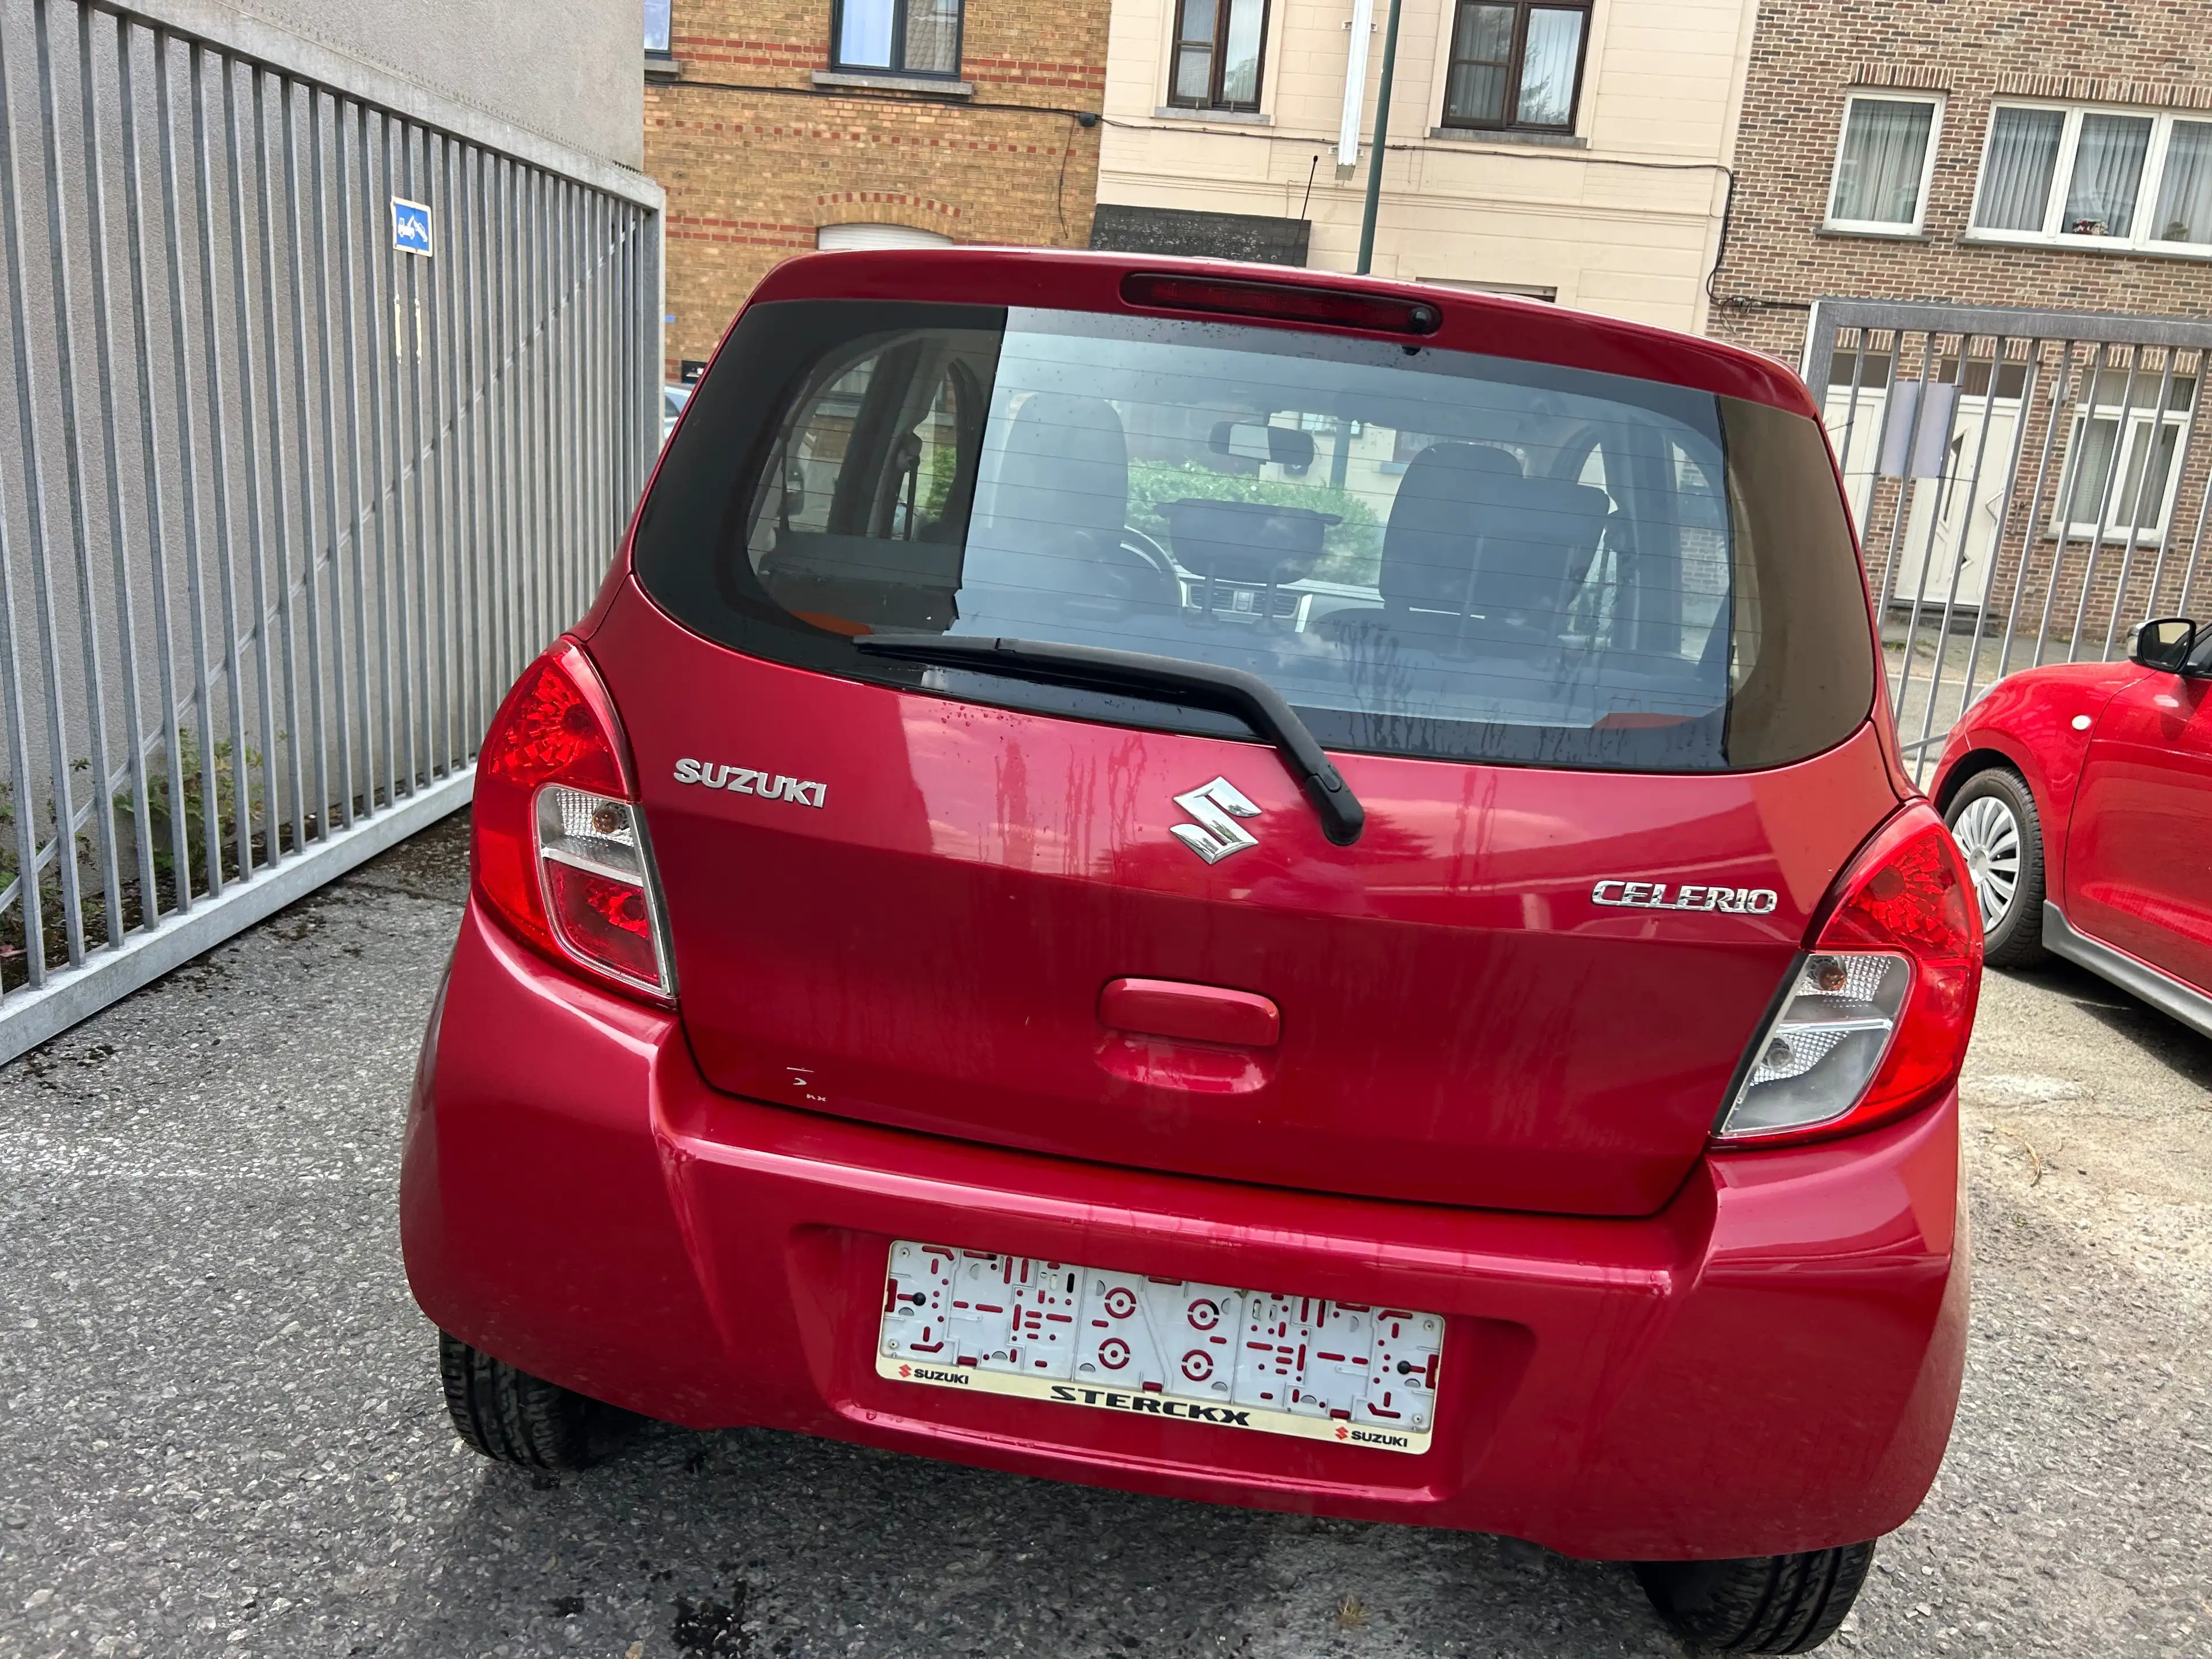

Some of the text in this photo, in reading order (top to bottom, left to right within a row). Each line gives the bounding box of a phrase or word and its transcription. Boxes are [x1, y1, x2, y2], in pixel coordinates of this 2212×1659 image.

[673, 757, 827, 809] SUZUKI
[1591, 880, 1779, 915] CELERIO
[914, 1369, 969, 1384] SUZUKI
[1050, 1385, 1251, 1426] STERCKX
[1351, 1430, 1408, 1447] SUZUKI
